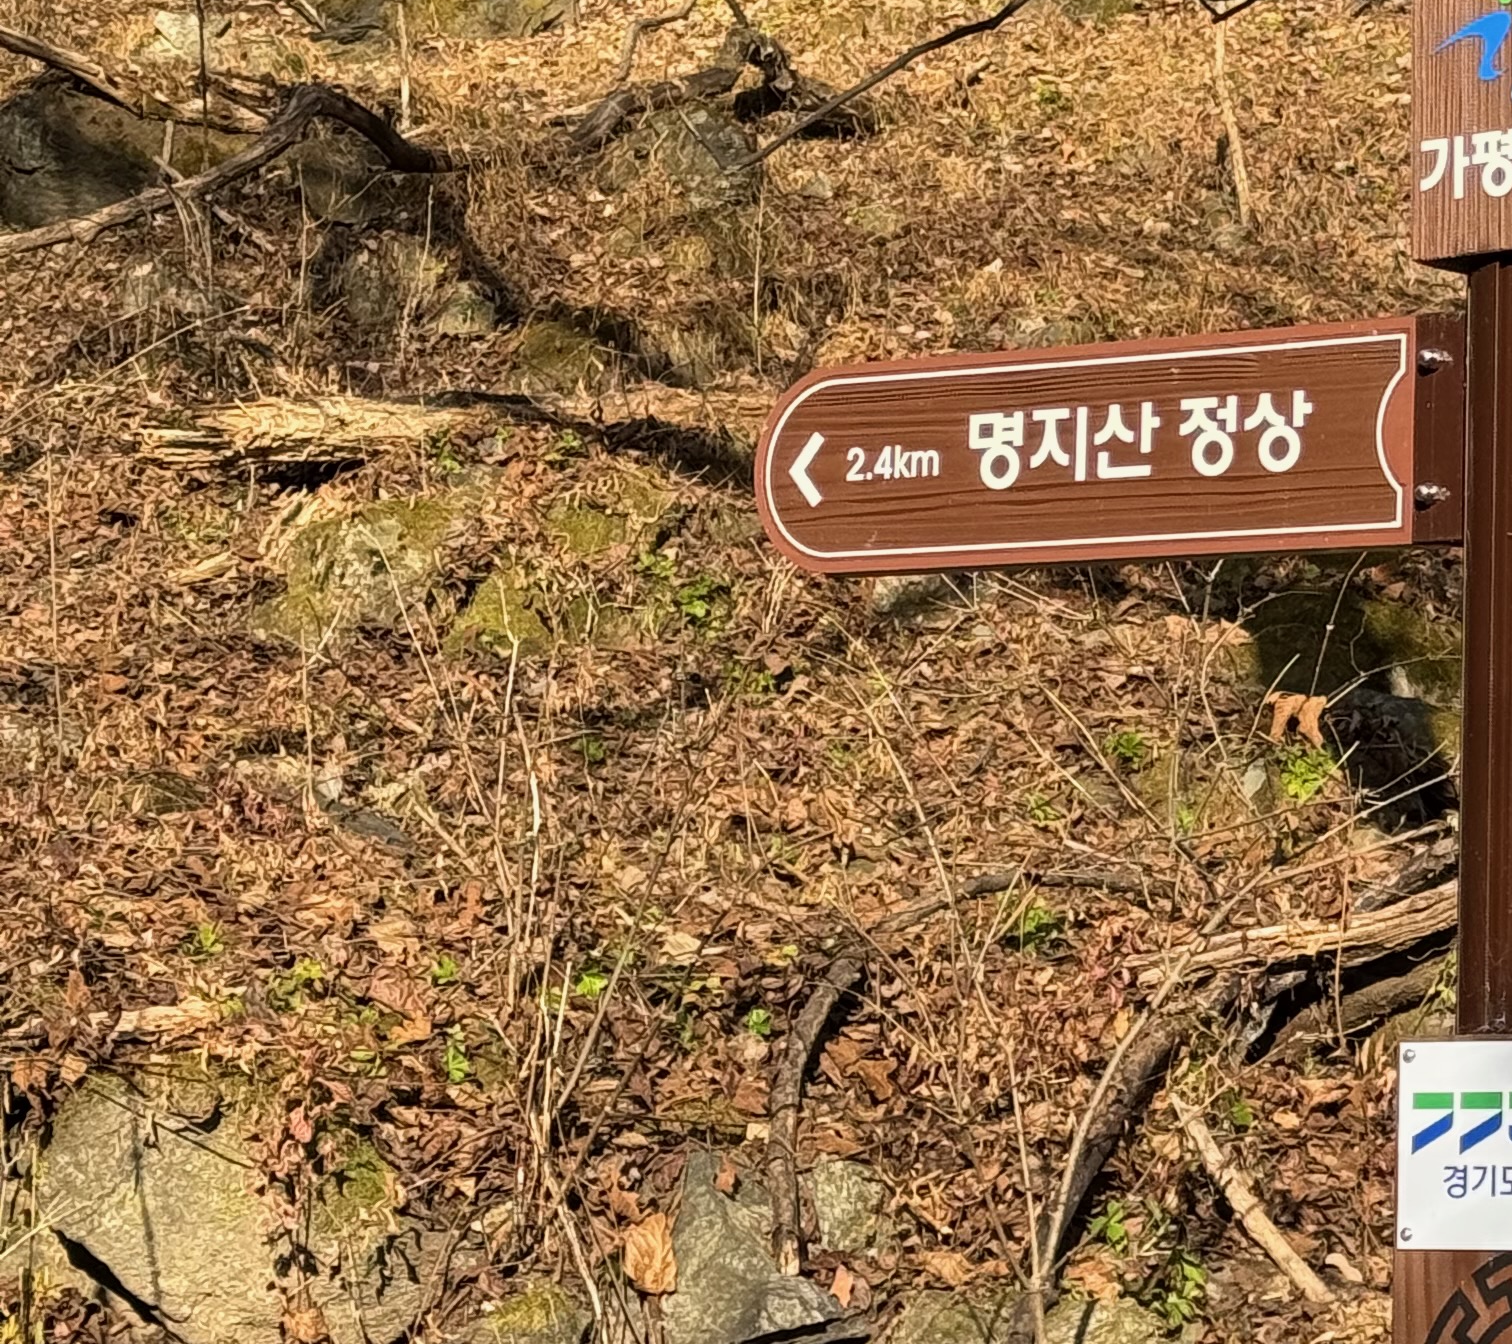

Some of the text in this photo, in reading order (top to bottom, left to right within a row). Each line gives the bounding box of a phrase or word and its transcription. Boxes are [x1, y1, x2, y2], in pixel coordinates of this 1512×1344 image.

[846, 390, 1312, 490] 2.4km 명지산 정상
